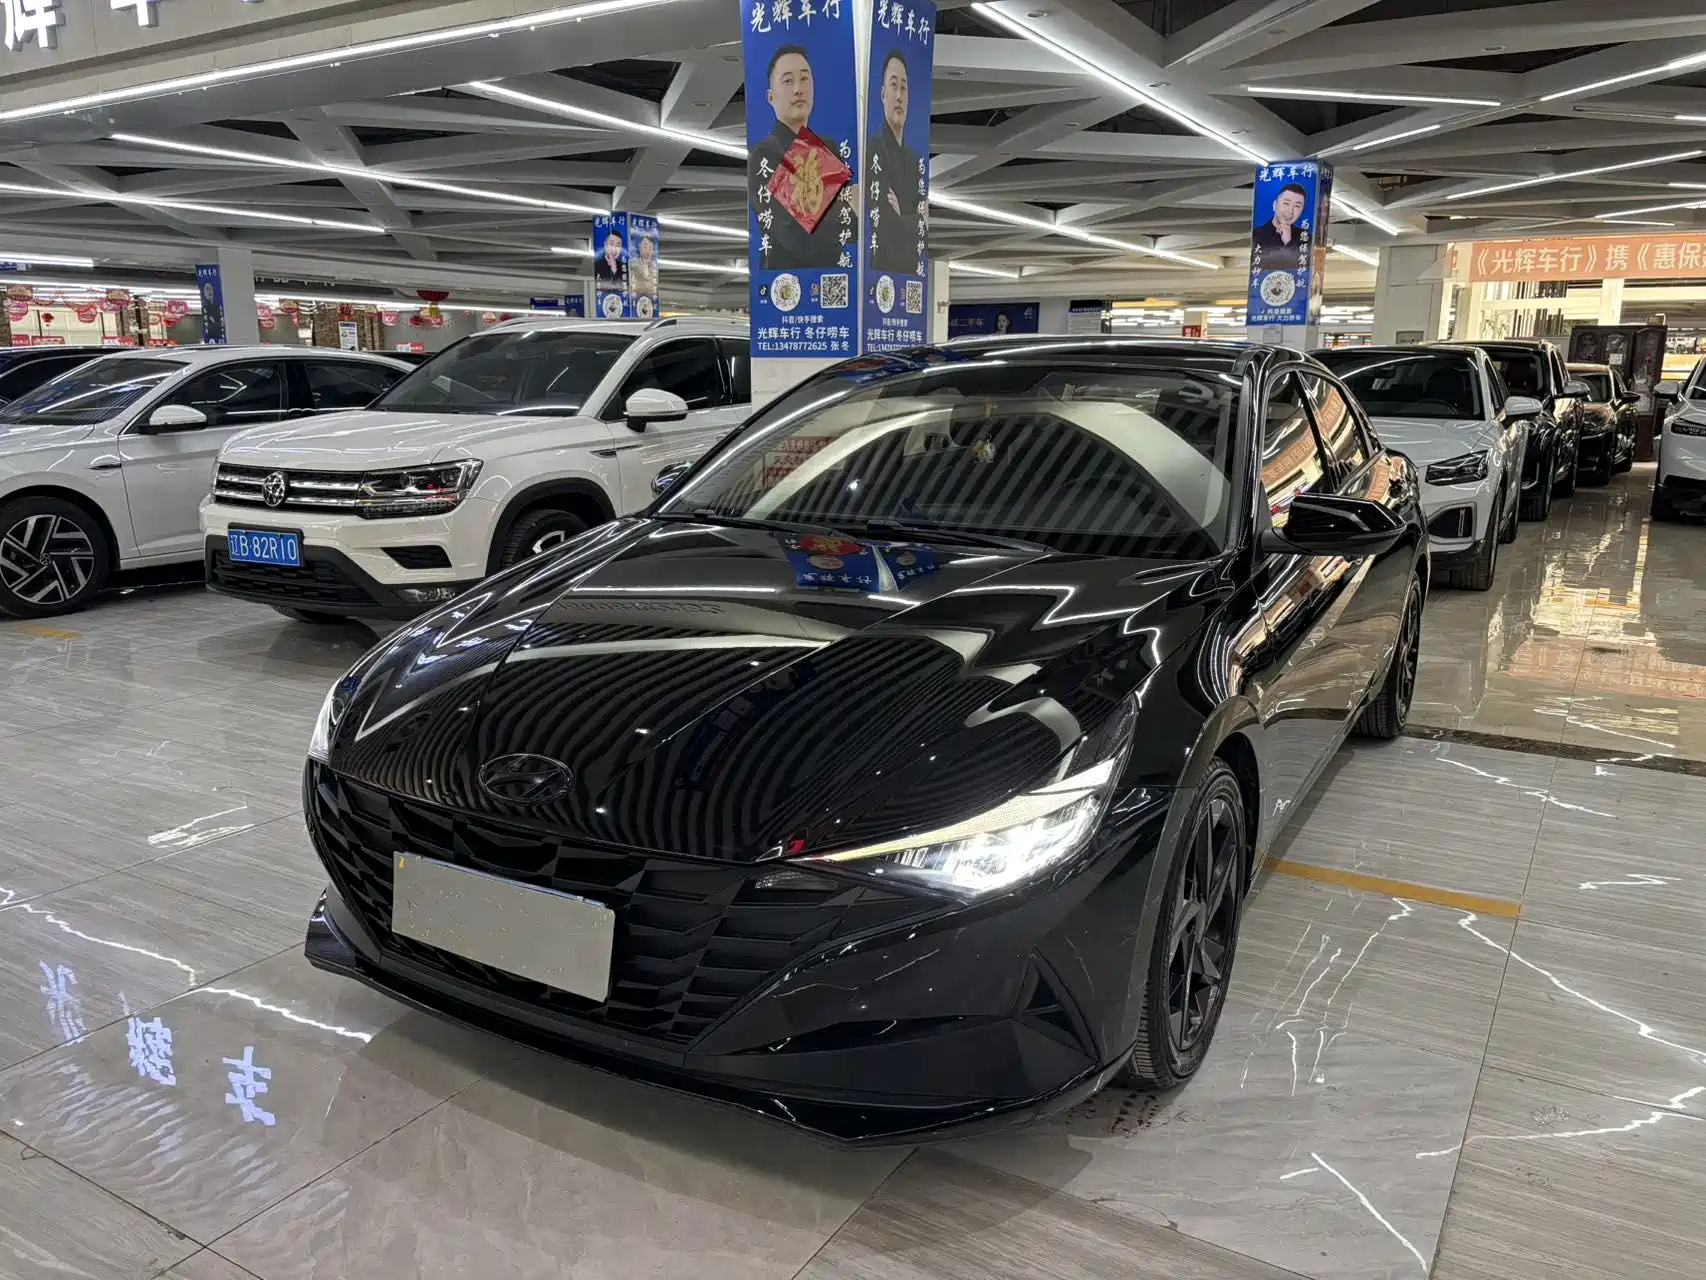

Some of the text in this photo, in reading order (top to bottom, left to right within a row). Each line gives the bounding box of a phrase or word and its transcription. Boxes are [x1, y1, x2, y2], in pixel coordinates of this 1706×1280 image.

[750, 0, 840, 33] 光辉车行
[877, 0, 931, 46] 光辉车行
[1259, 166, 1314, 182] 光辉车行
[837, 138, 854, 268] 为保驾护航
[757, 326, 850, 340] 光辉车行 冬仔唠车
